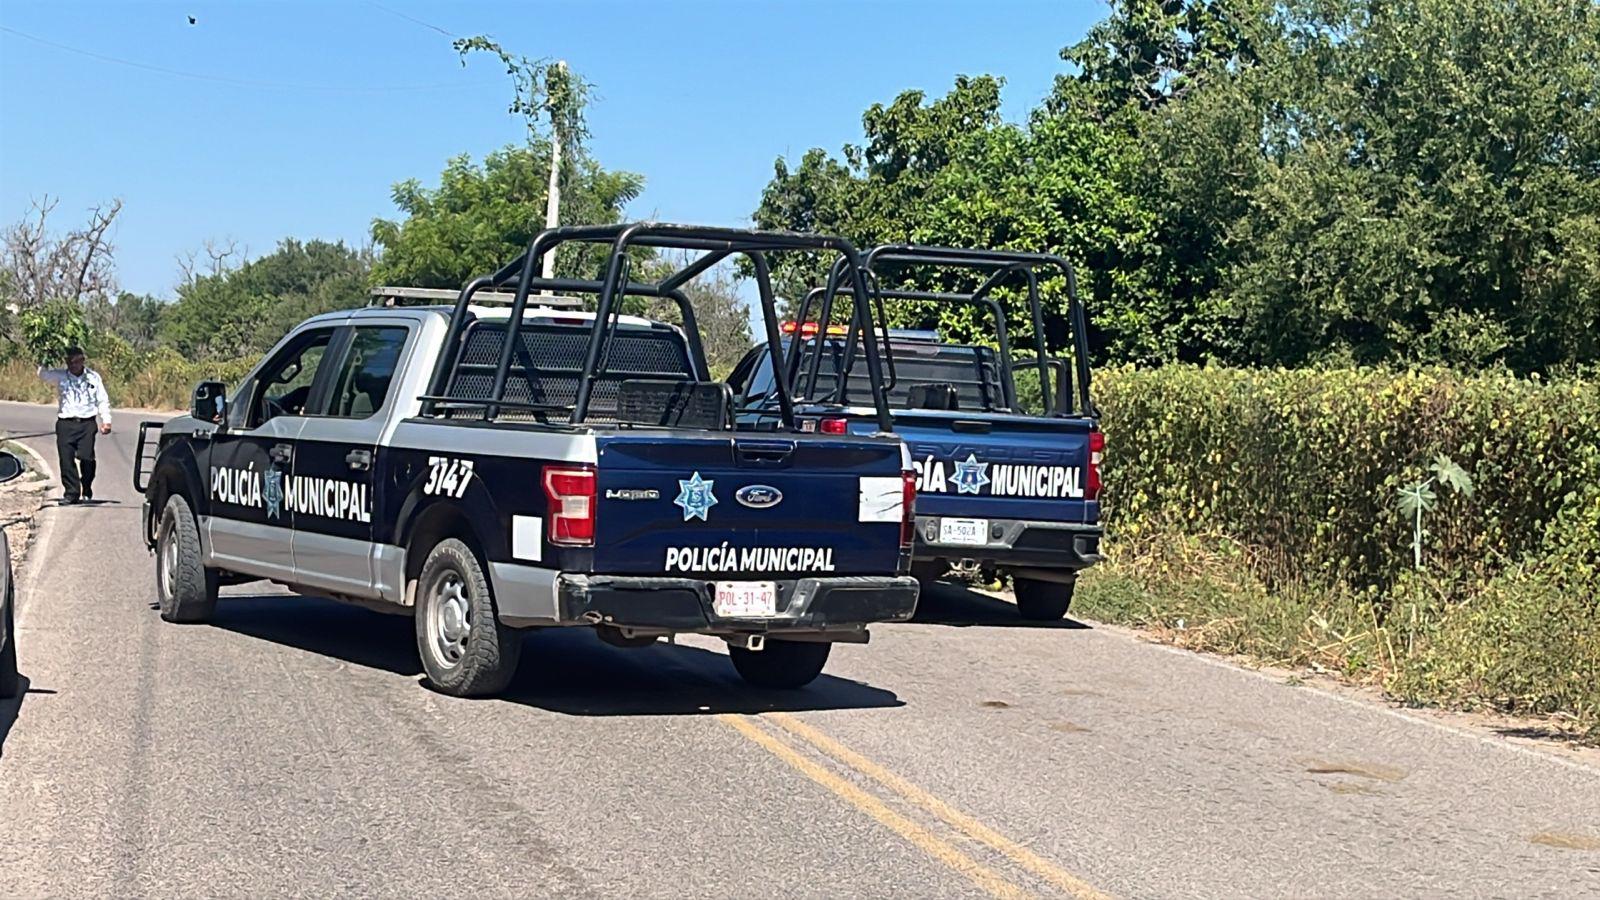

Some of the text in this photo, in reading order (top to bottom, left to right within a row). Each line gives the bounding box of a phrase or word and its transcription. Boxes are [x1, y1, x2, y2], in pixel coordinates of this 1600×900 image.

[210, 461, 371, 523] POLICÍA MUNICIPAL
[423, 456, 474, 498] 3147
[990, 464, 1084, 498] MUNICIPAL
[665, 541, 835, 572] POLICÍA MUNICIPAL
[719, 591, 773, 606] POL-31-47
